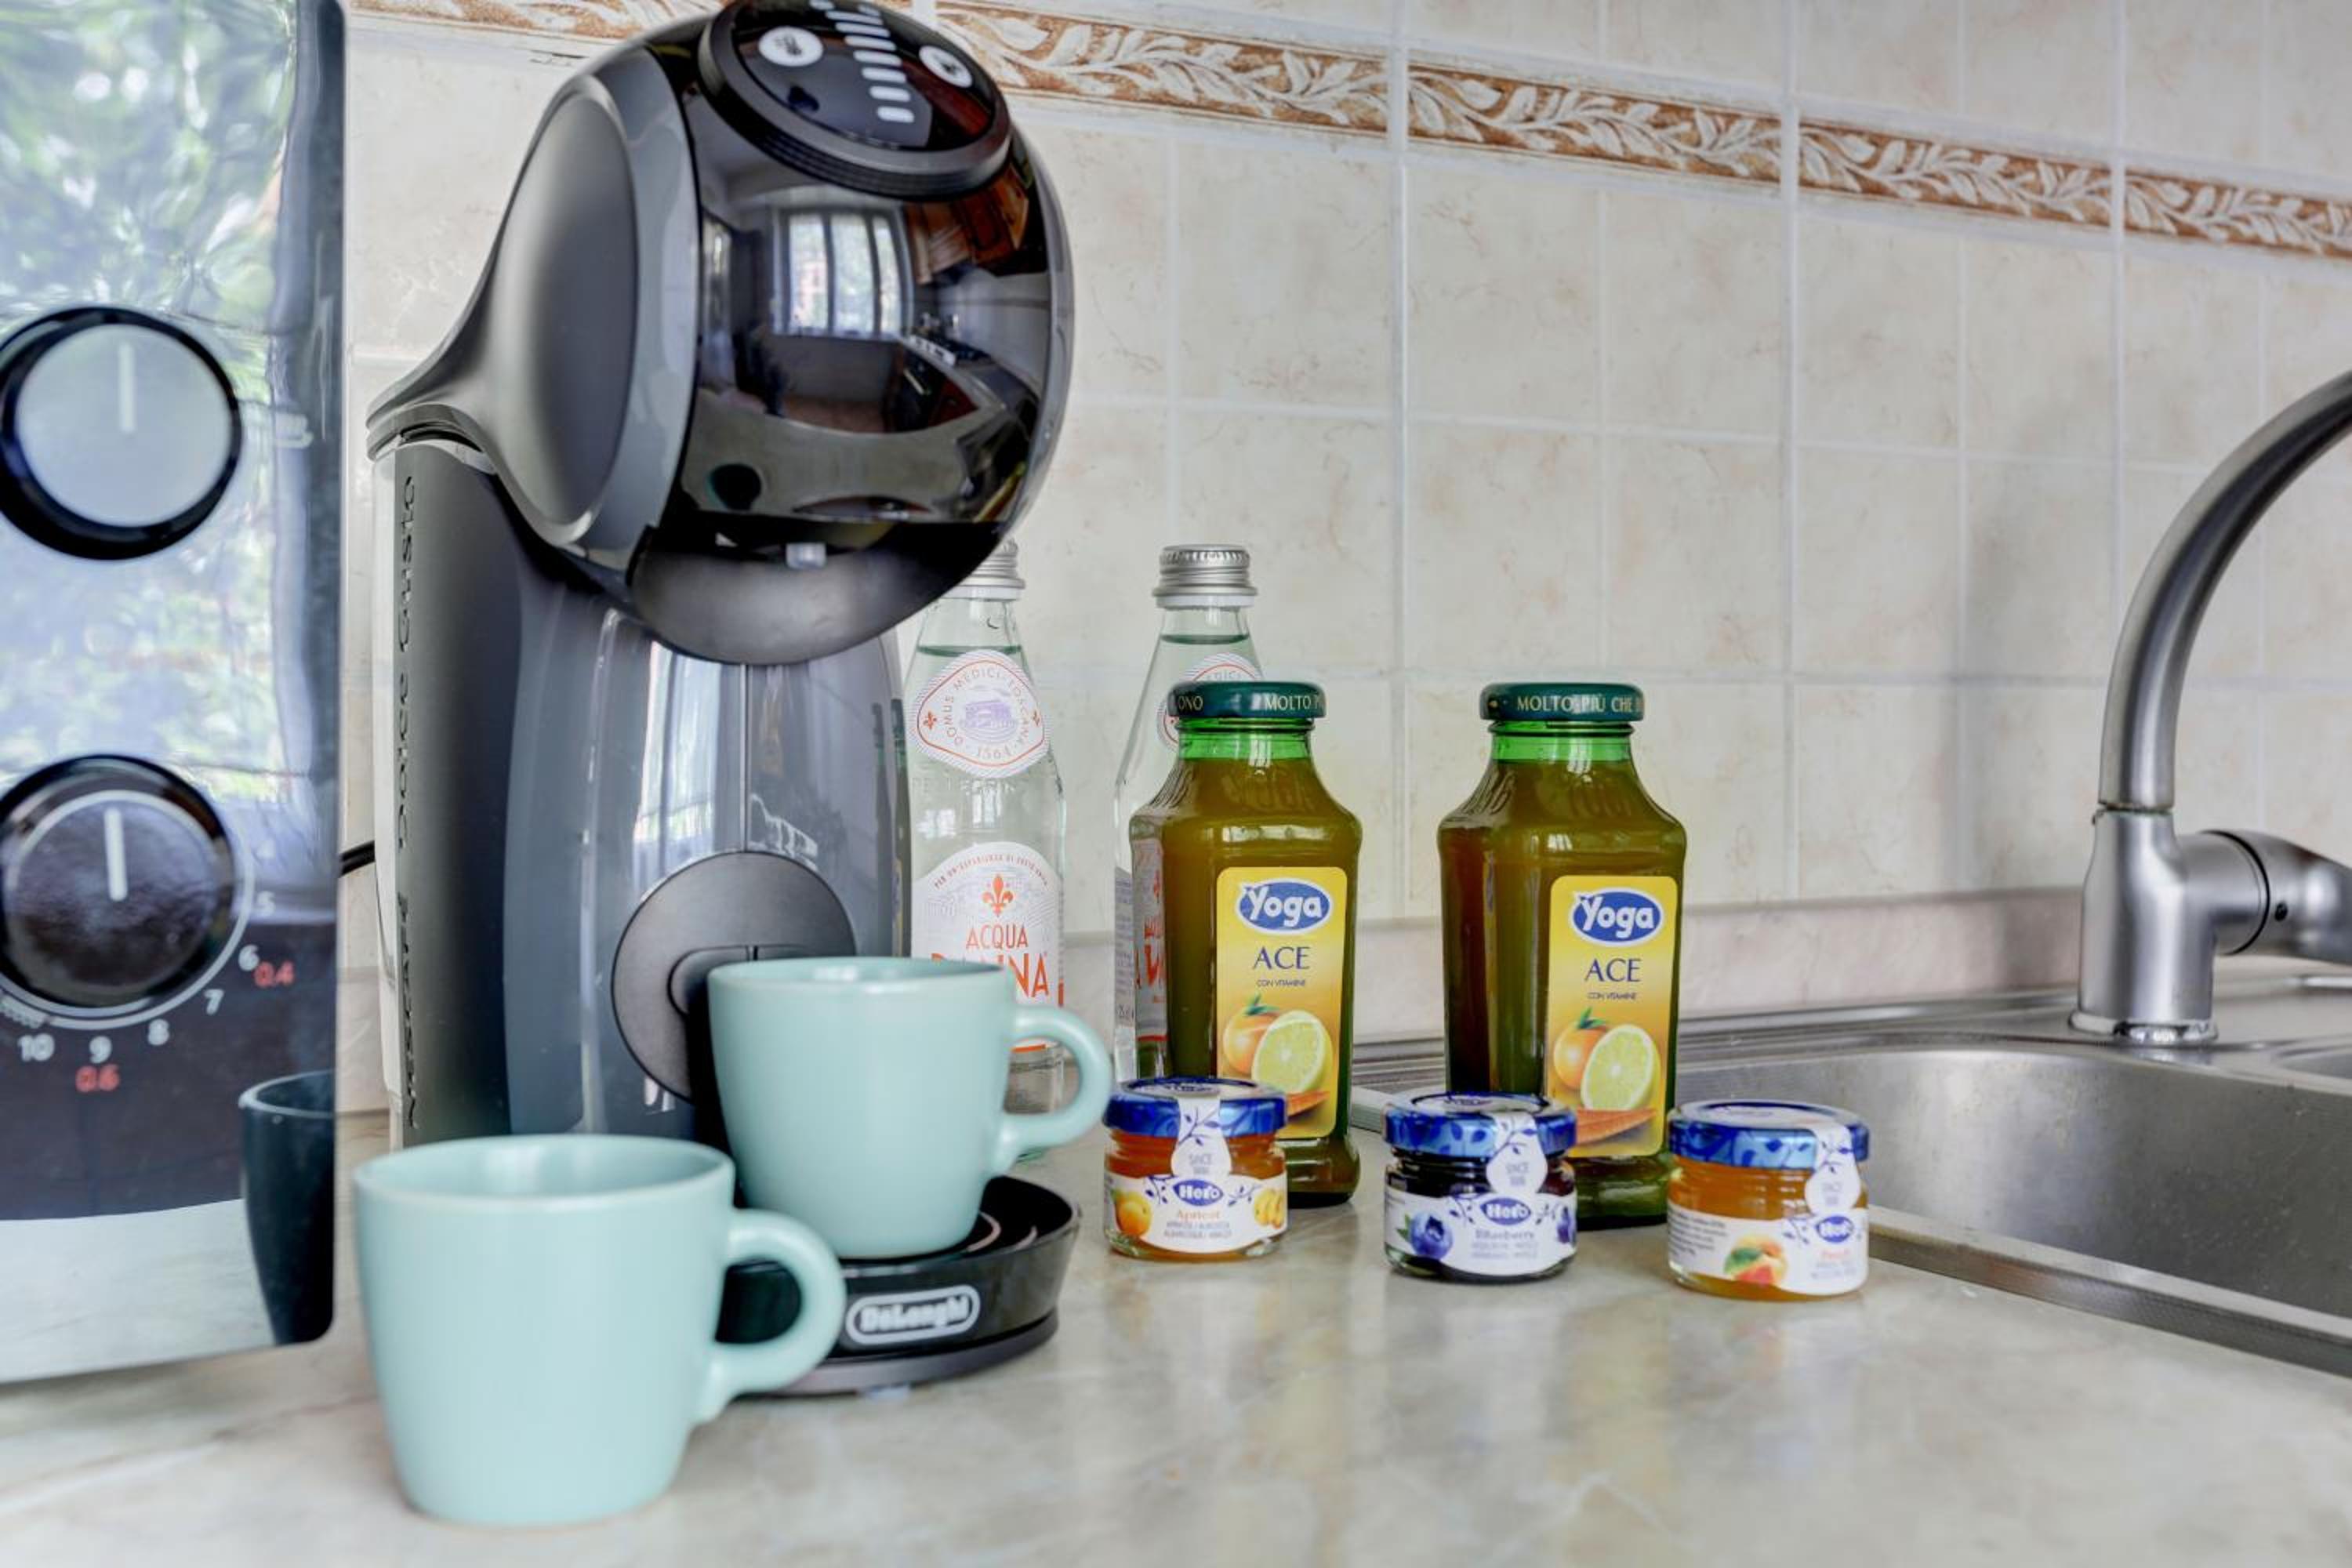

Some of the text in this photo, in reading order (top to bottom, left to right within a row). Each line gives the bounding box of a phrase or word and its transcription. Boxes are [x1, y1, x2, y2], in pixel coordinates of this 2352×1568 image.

[1265, 694, 1312, 711] MOLTO
[1517, 695, 1573, 712] MOLTO
[1611, 695, 1633, 713] CHE
[256, 891, 276, 917] 5
[1242, 883, 1323, 928] Yoga
[1576, 894, 1655, 939] Yoga
[966, 924, 1029, 949] ACQUA
[238, 944, 260, 971] 6
[1252, 946, 1311, 971] ACE
[1584, 957, 1642, 982] ACE
[204, 988, 224, 1015] 7
[147, 1018, 171, 1046] 8
[17, 1033, 56, 1062] 10
[89, 1035, 112, 1064] 9
[1178, 1185, 1220, 1200] Hero
[1486, 1203, 1528, 1218] Hero
